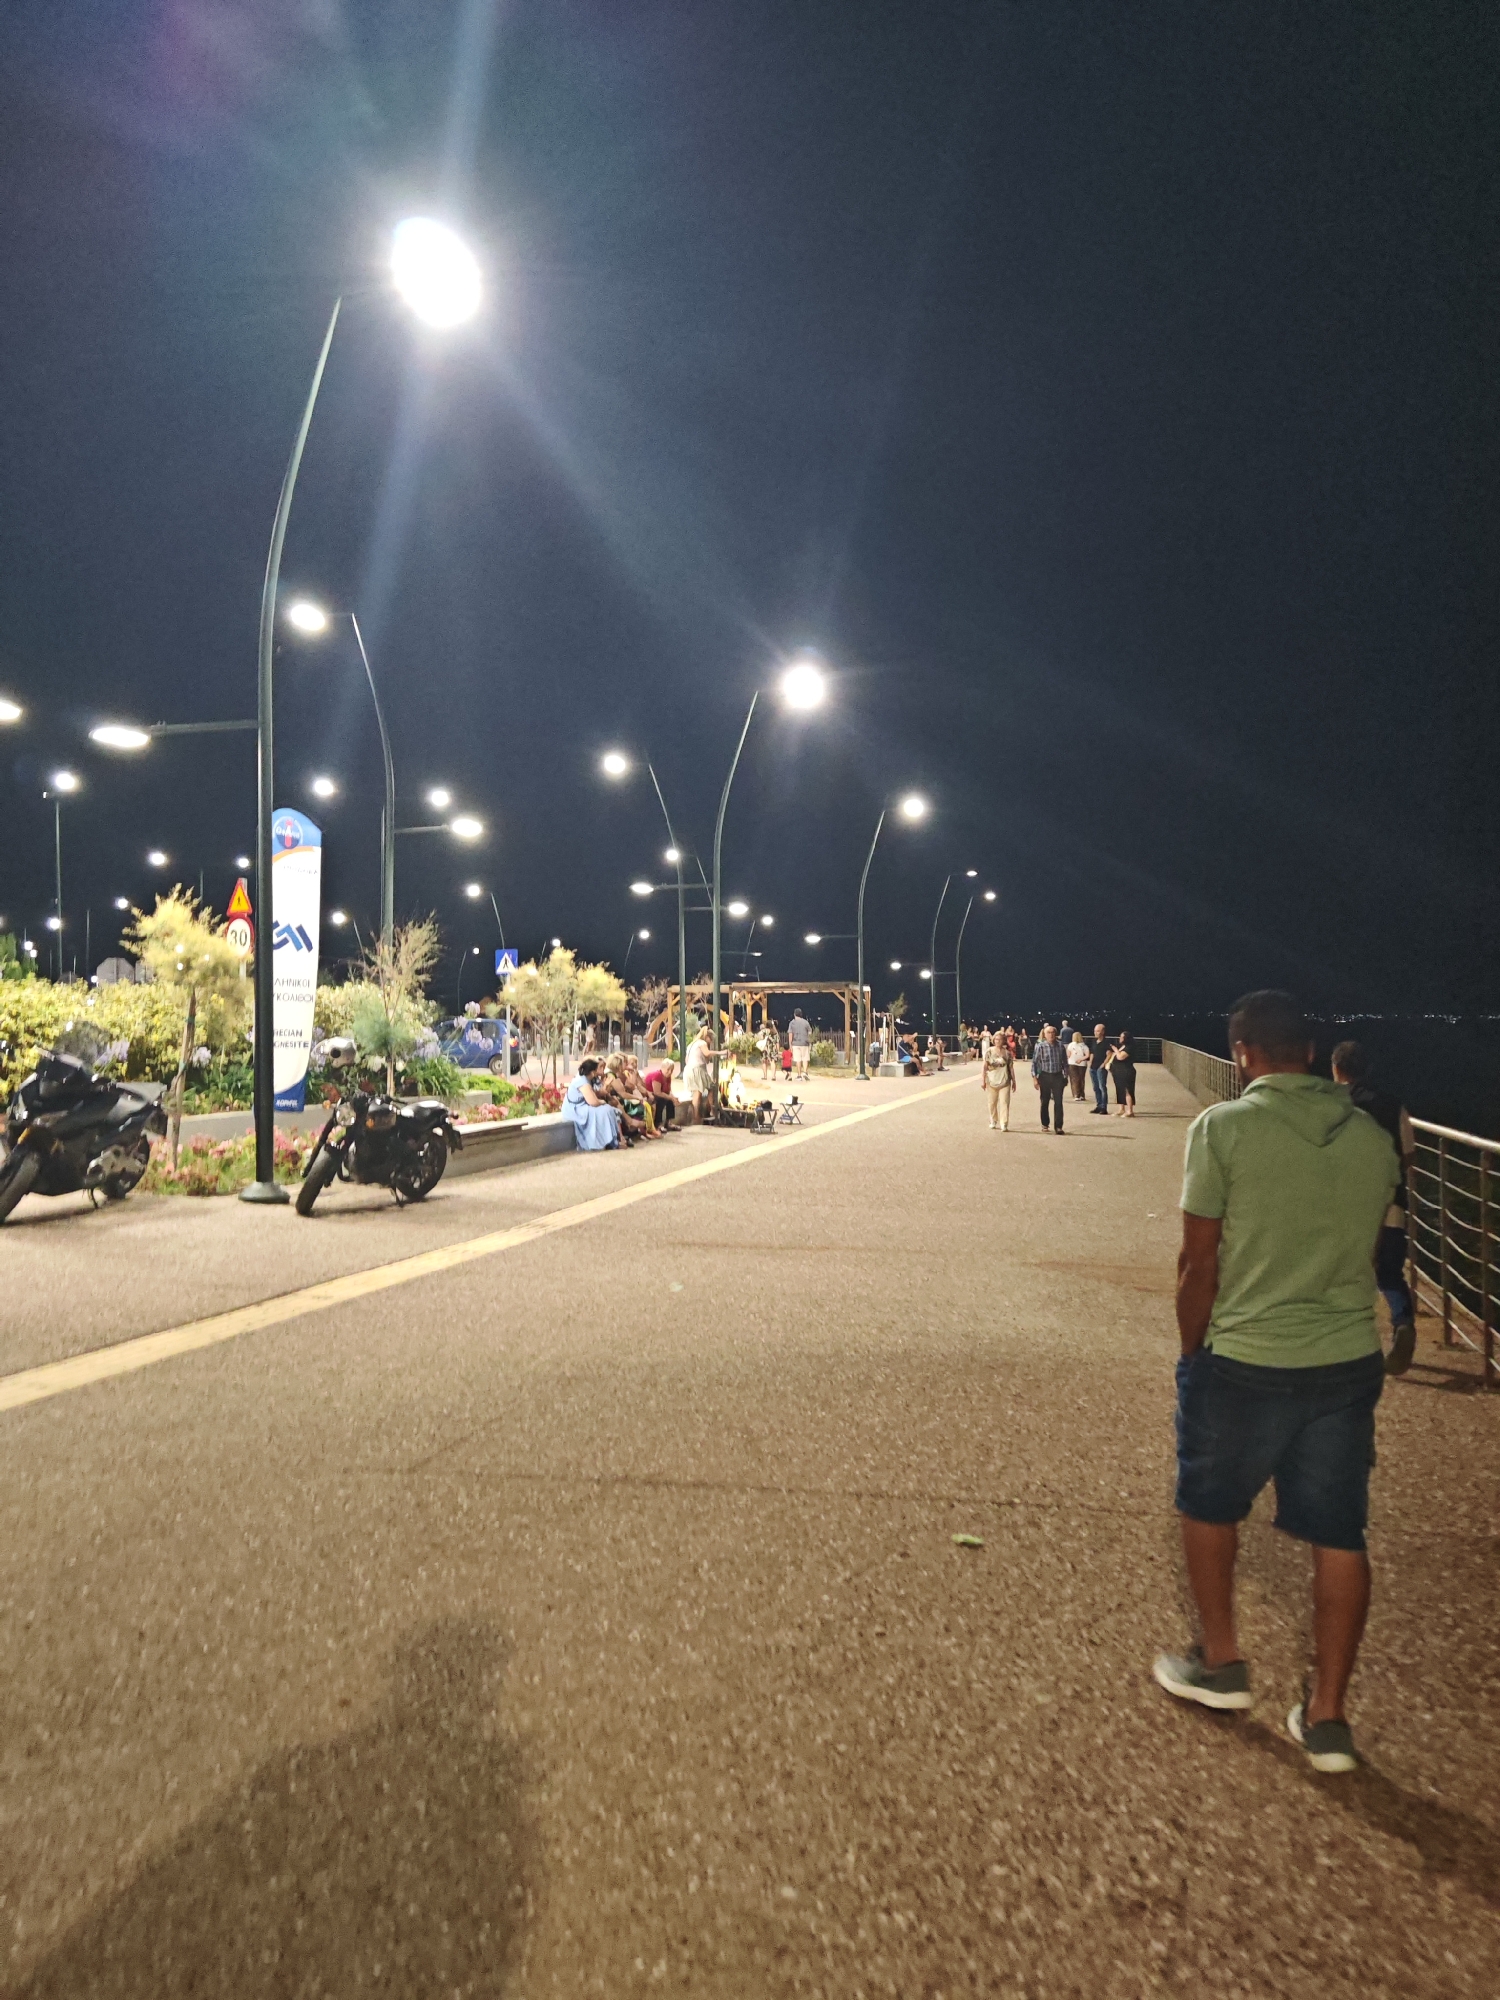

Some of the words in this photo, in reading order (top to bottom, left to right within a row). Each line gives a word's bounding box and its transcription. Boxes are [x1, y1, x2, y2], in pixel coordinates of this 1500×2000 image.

[230, 928, 248, 947] 30
[274, 977, 310, 989] ΛΗΝΙΚΟΙ
[273, 1028, 303, 1038] RECIAN
[273, 1040, 310, 1050] GNESITE
